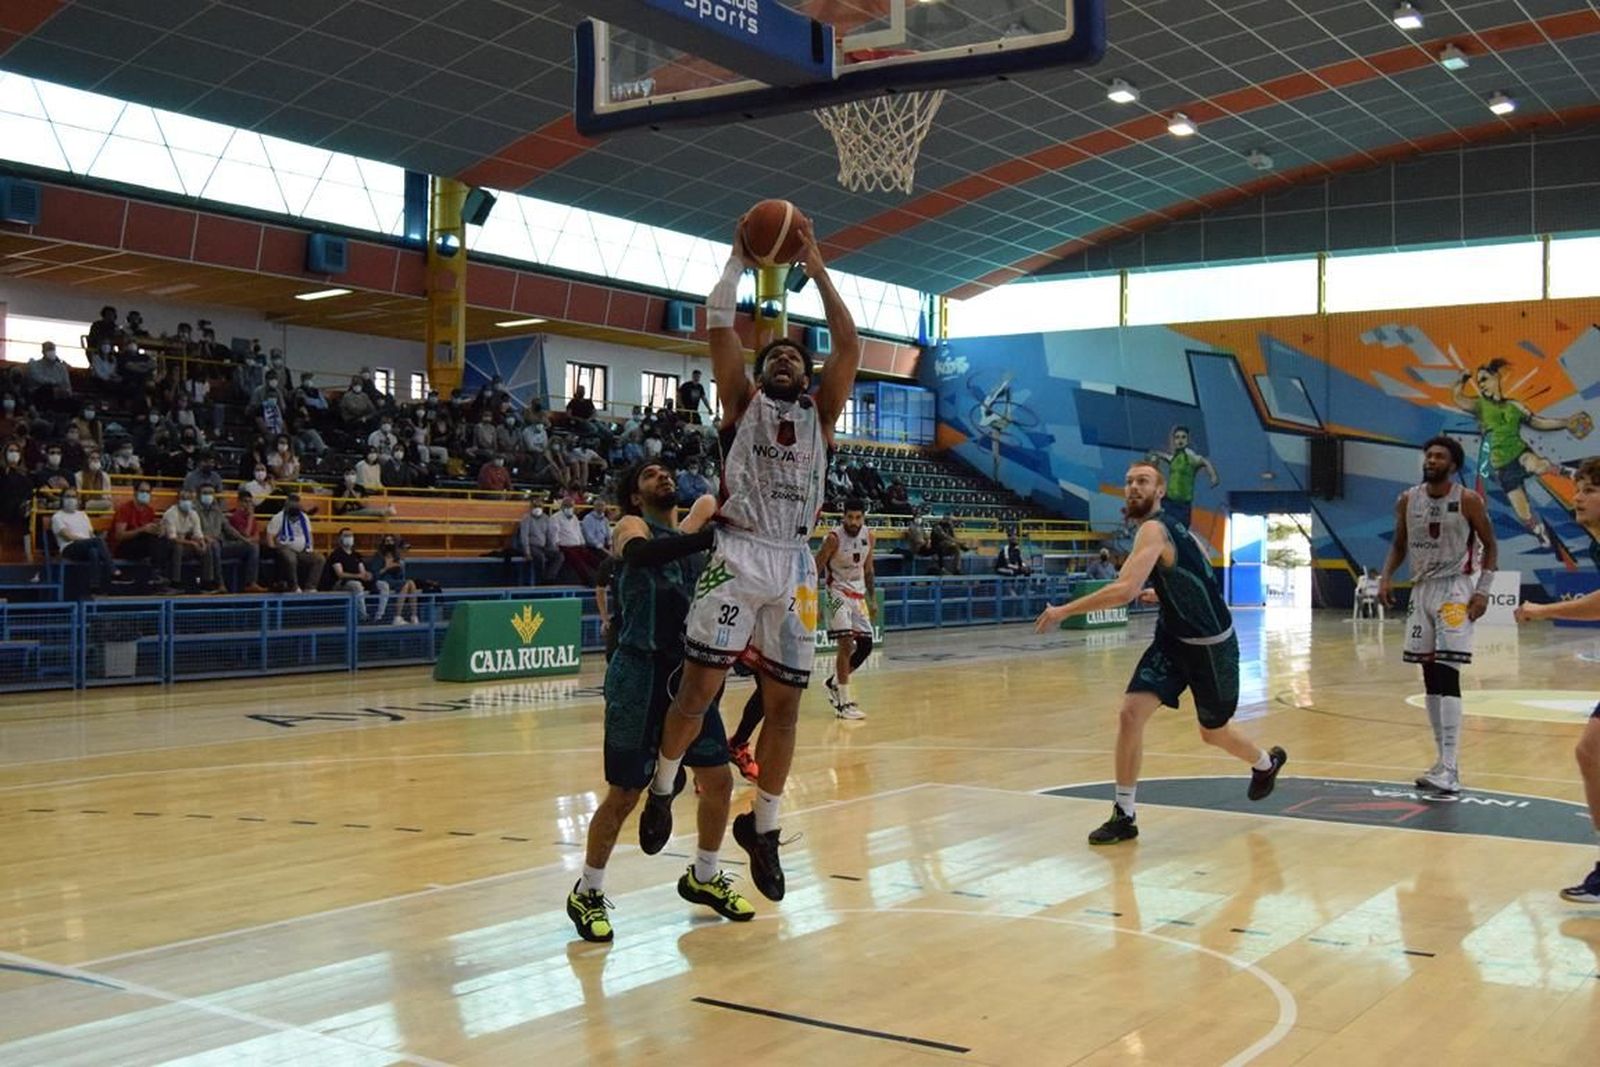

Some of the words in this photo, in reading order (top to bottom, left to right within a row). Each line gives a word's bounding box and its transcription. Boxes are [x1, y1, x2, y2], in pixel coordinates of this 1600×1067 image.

[718, 604, 739, 626] 32
[1412, 625, 1422, 638] 22
[470, 650, 517, 673] CAJA
[518, 645, 579, 670] RURAL
